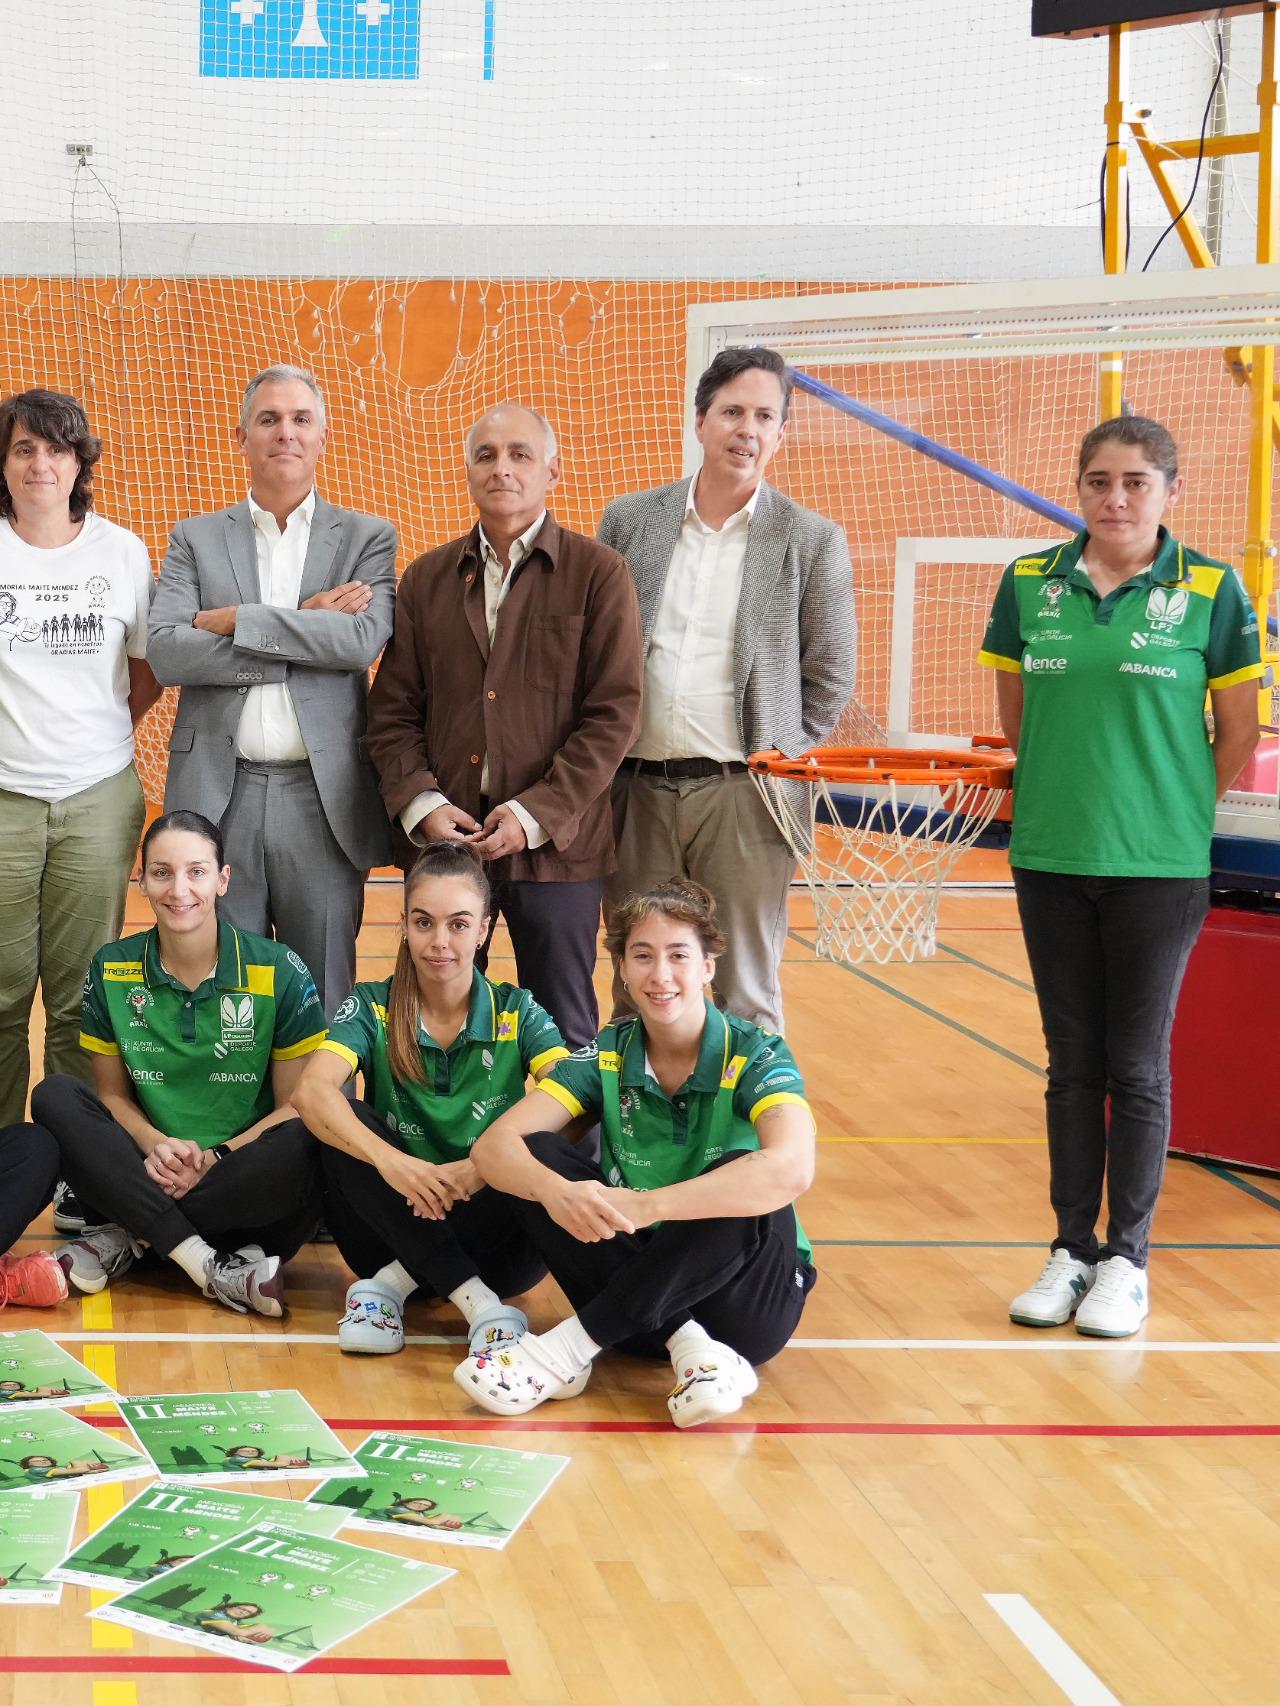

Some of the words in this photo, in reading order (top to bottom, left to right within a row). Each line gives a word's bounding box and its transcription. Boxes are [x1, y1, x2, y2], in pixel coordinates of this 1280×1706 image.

[35, 594, 69, 602] 2025
[1150, 621, 1173, 633] LF2
[1032, 656, 1068, 671] ence
[133, 1070, 164, 1081] ence
[129, 1403, 173, 1419] II
[365, 1441, 415, 1460] II
[141, 1491, 193, 1513] II
[230, 1535, 292, 1558] II
